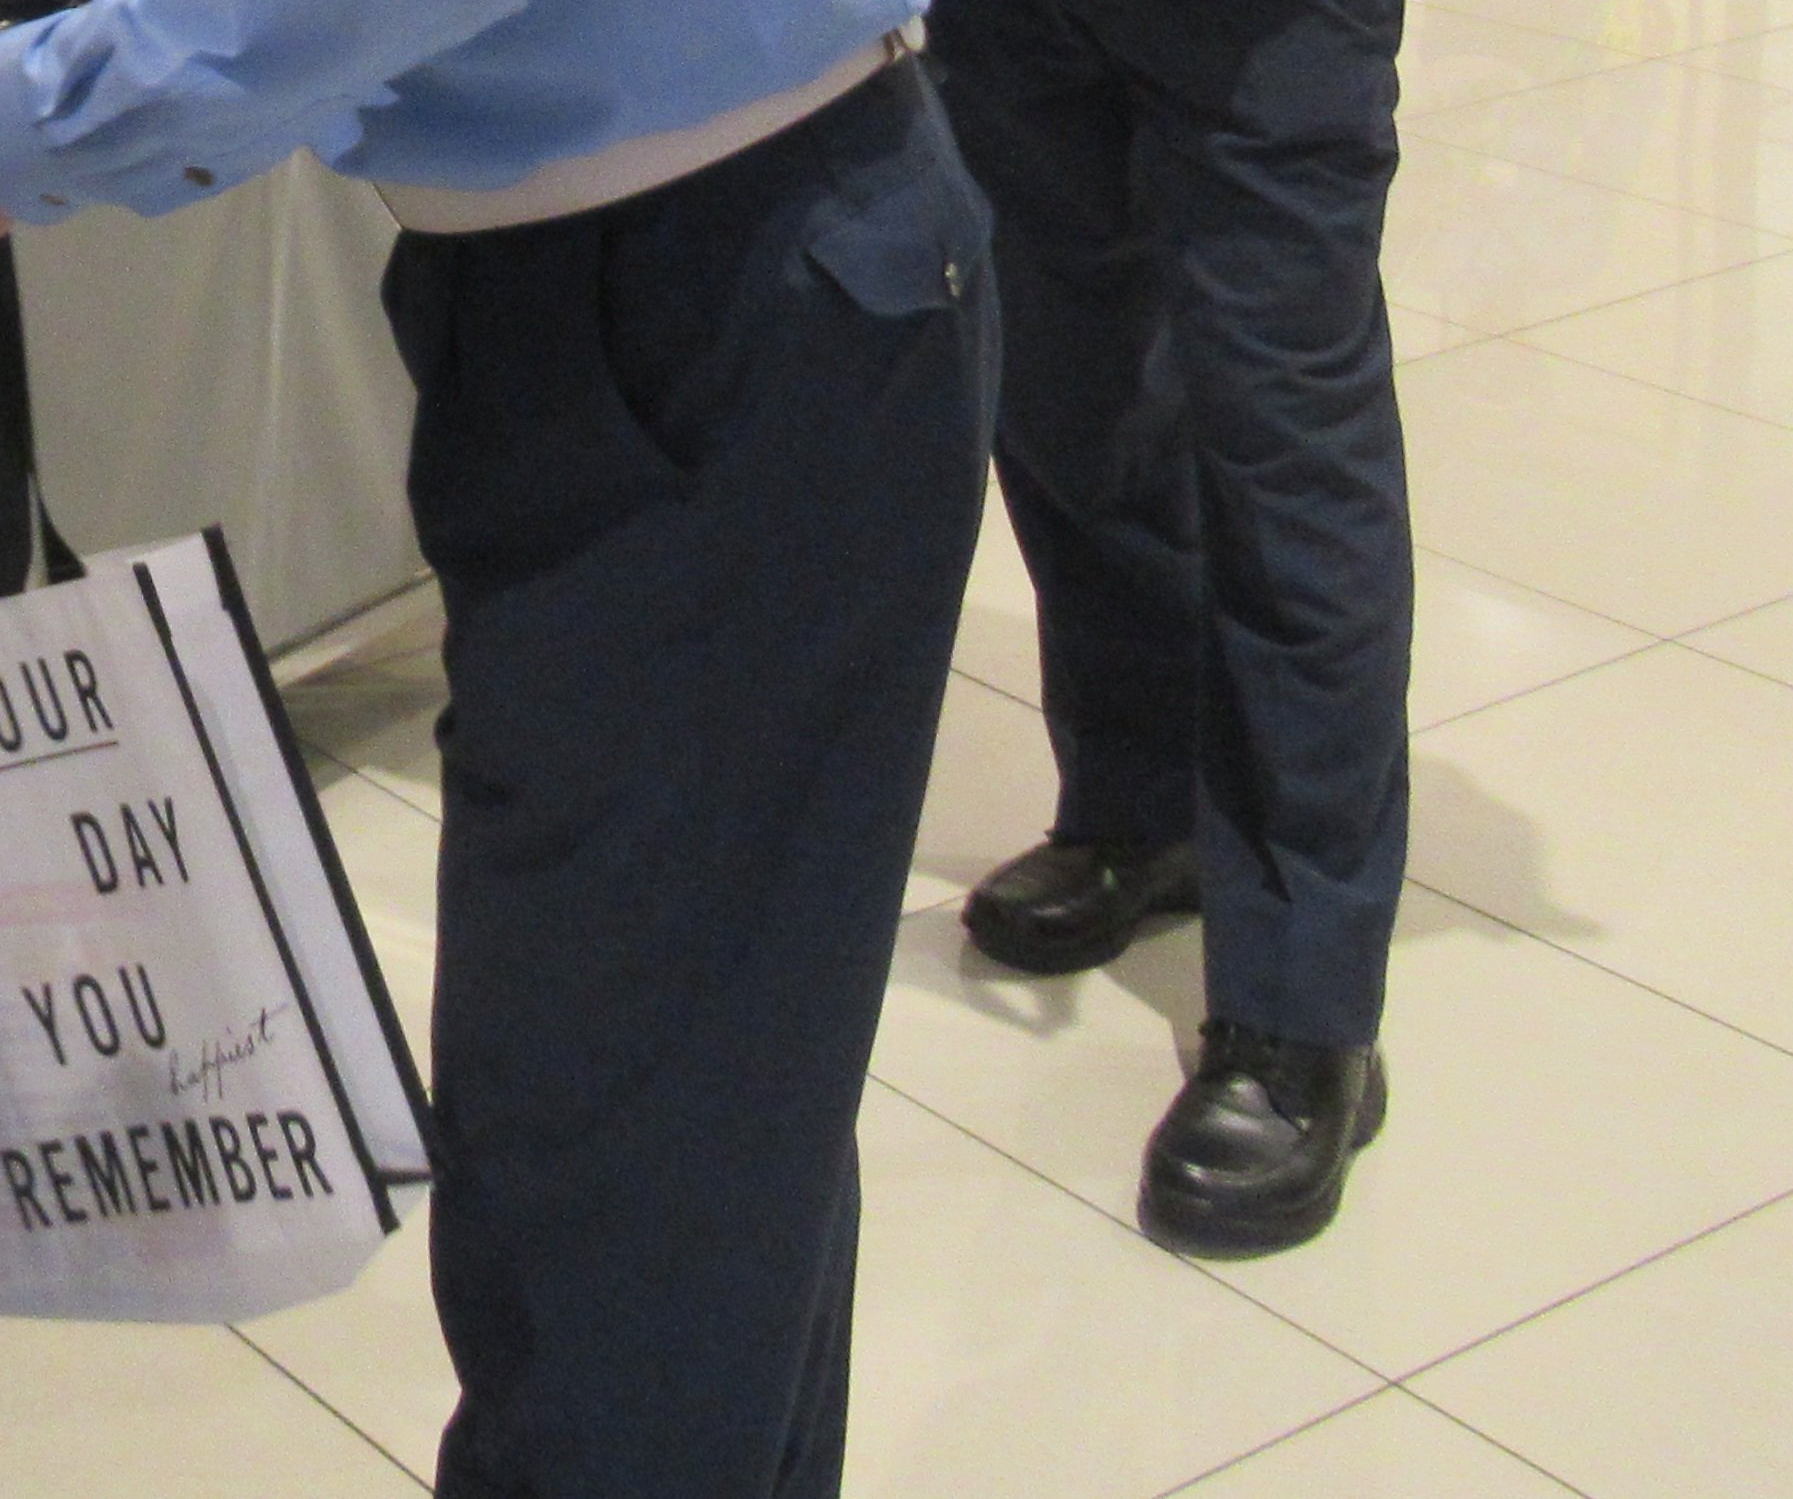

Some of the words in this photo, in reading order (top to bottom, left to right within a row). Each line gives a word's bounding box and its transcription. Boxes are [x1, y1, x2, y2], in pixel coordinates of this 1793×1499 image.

[70, 796, 192, 895] DAY
[21, 963, 166, 1067] YOU
[0, 1109, 334, 1232] REMEMBER
